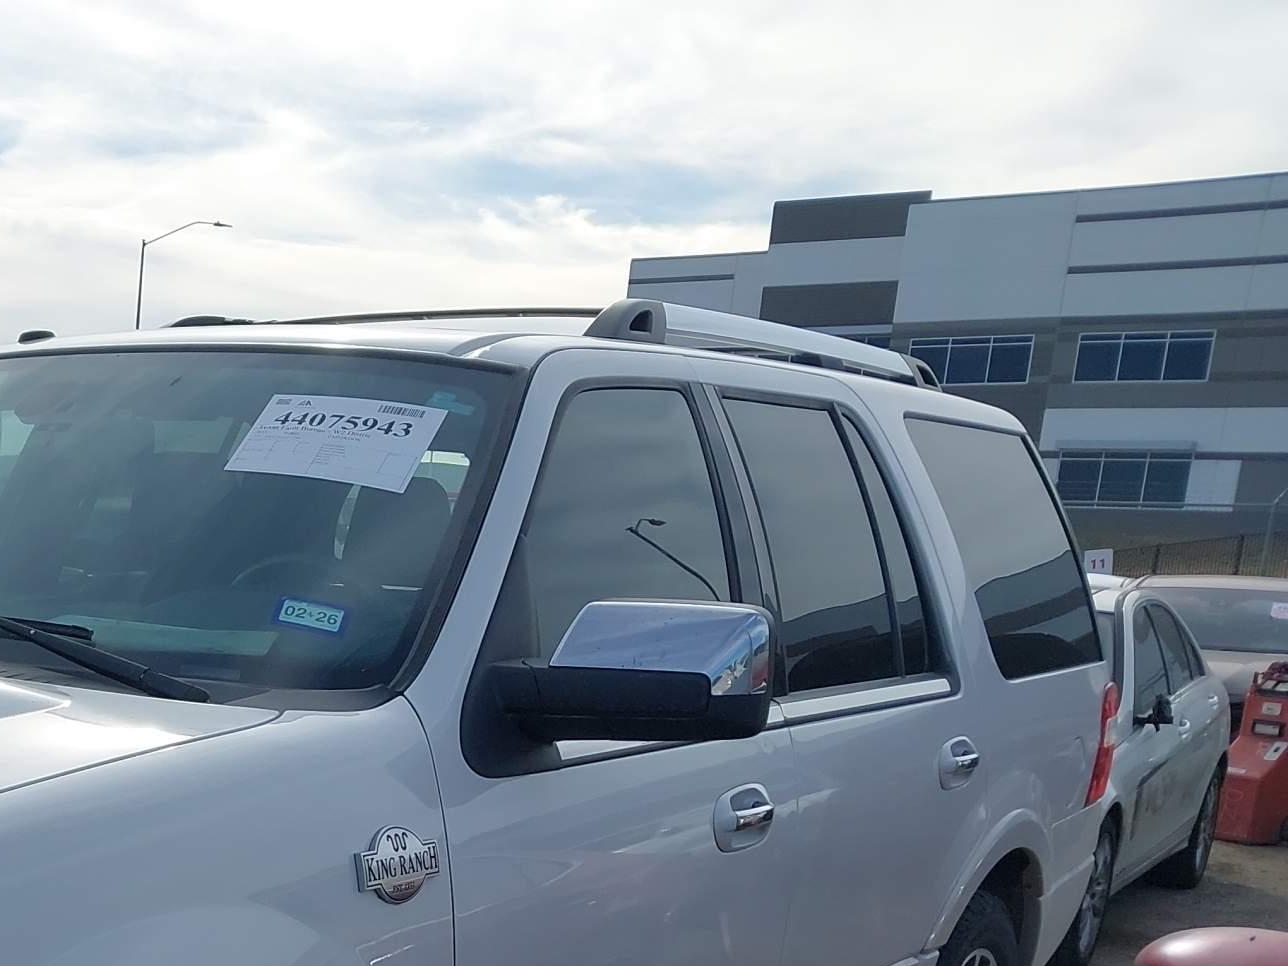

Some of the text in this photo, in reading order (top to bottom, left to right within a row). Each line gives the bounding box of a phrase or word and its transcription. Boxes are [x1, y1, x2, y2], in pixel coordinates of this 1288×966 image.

[274, 410, 414, 438] 44075943
[1091, 558, 1105, 569] 11
[366, 845, 438, 882] KING RANCH
